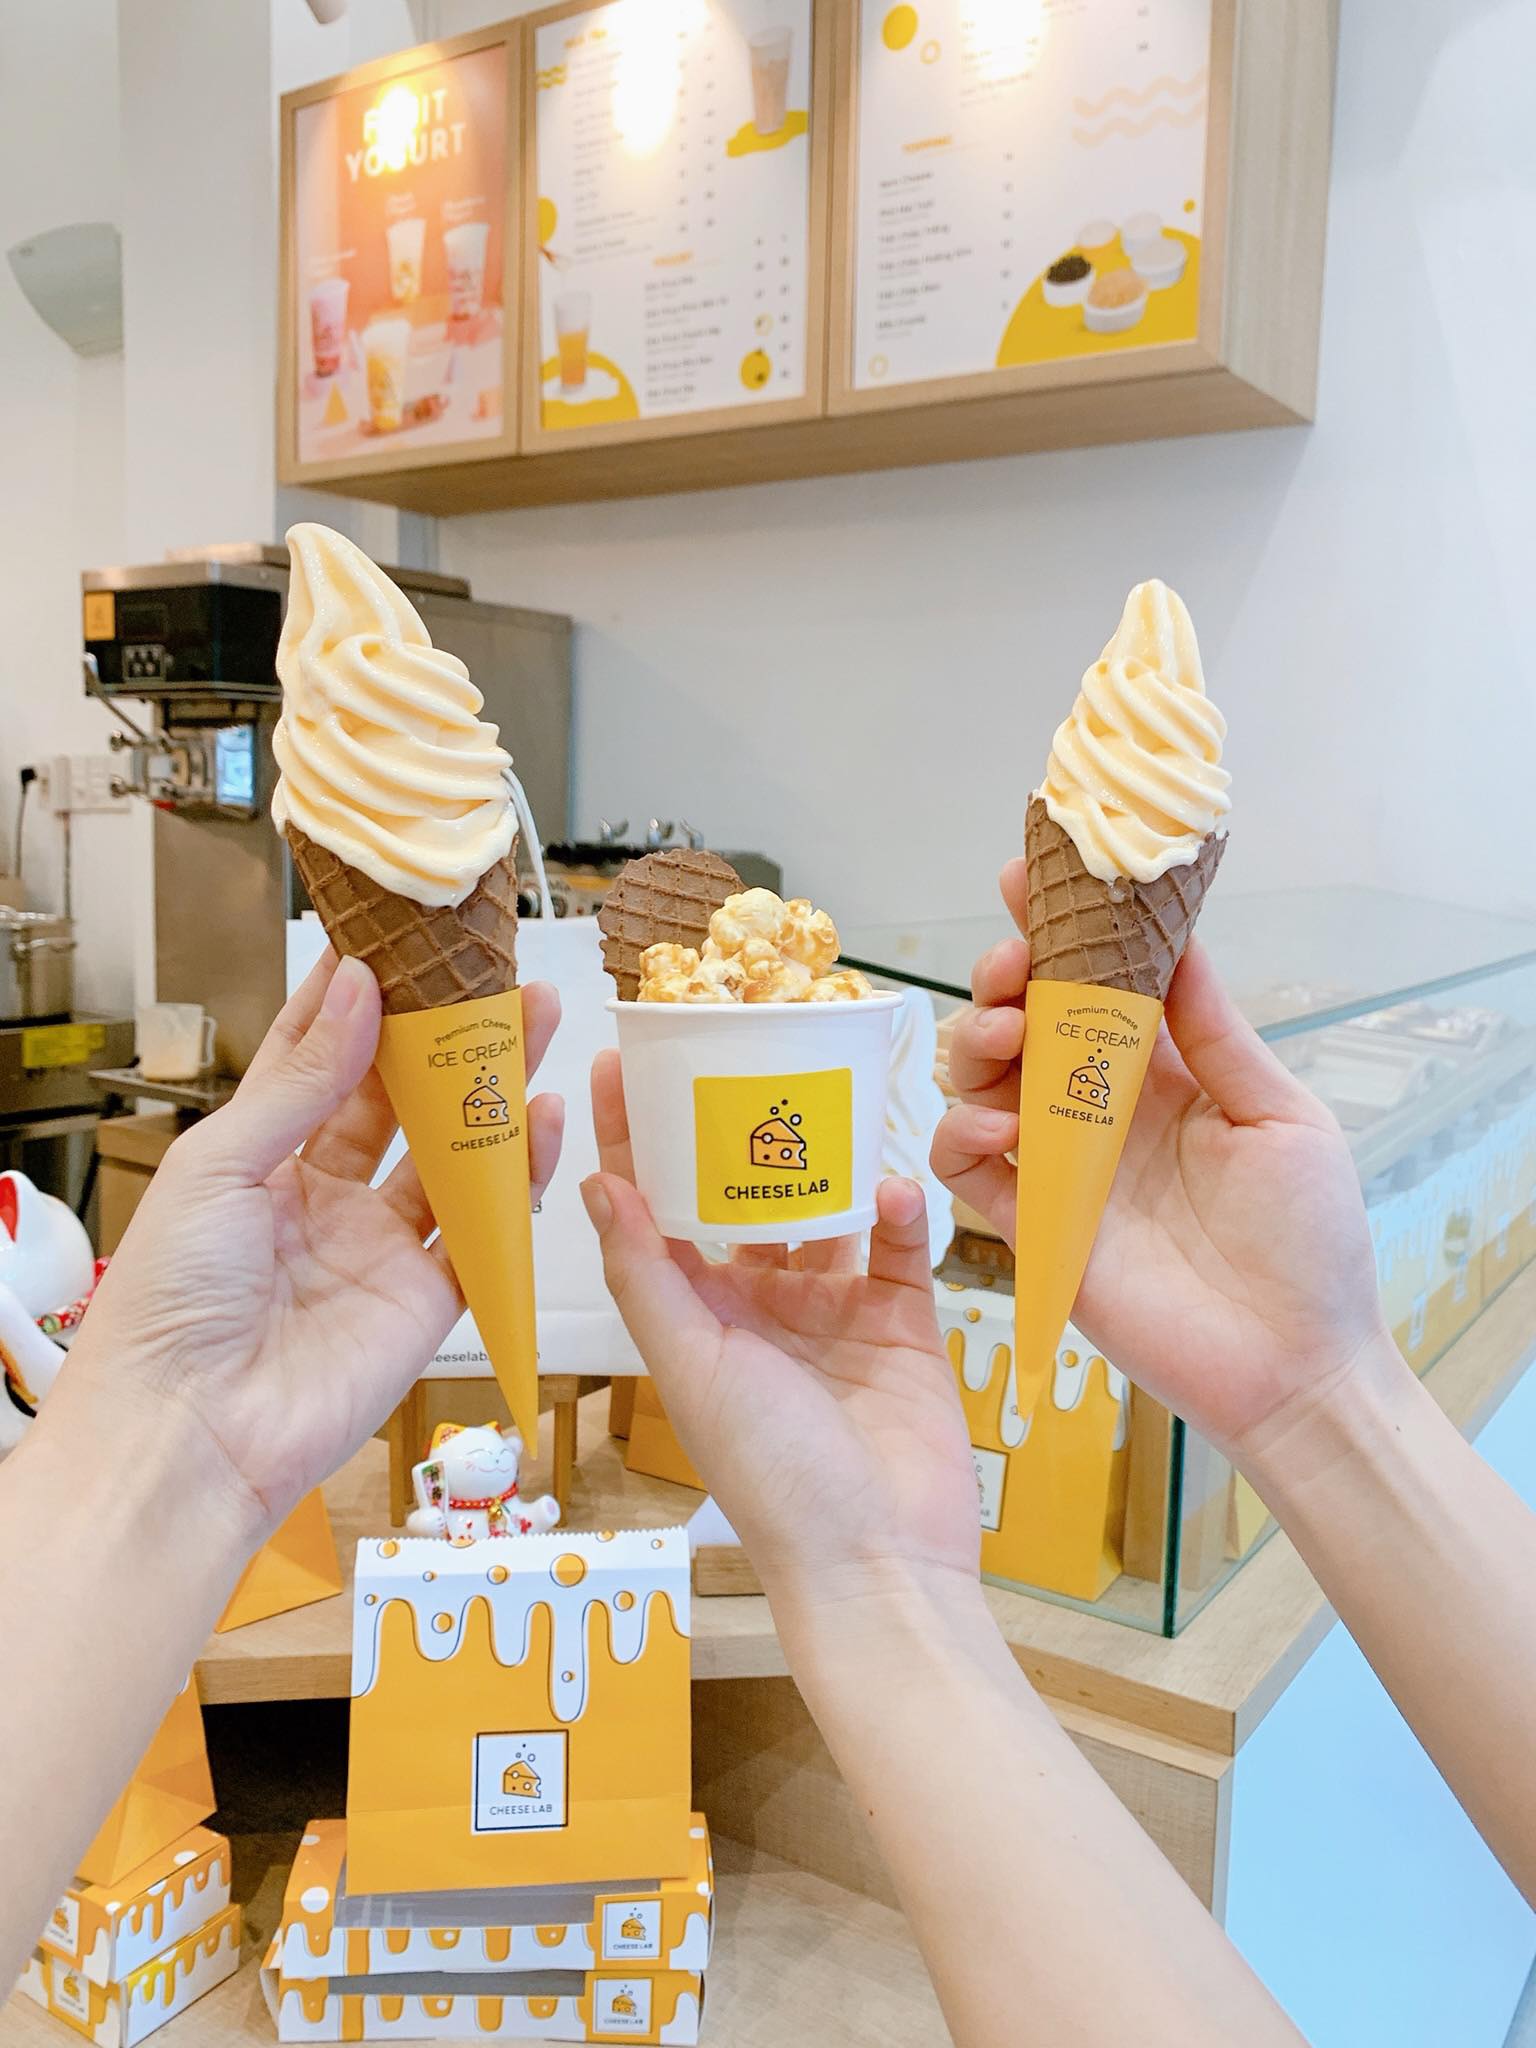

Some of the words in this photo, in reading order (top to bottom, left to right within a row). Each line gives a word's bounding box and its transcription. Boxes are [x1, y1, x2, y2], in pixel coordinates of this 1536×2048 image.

[363, 88, 447, 143] FIT
[1066, 1005, 1109, 1018] Premium
[1110, 1008, 1138, 1031] Cheese
[434, 1021, 480, 1046] Premium
[481, 1018, 511, 1032] Cheese
[1055, 1021, 1081, 1039] ICE
[1085, 1028, 1140, 1050] CREAM
[427, 1050, 458, 1069] ICE
[462, 1035, 519, 1064] CREAM
[1048, 1104, 1093, 1124] CHEESE
[1094, 1114, 1114, 1126] LAB
[450, 1134, 500, 1152] CHEESE
[724, 1183, 794, 1200] CHEESE
[797, 1178, 830, 1197] LAB
[489, 1804, 530, 1816] CHEESE
[531, 1803, 553, 1814] LAB
